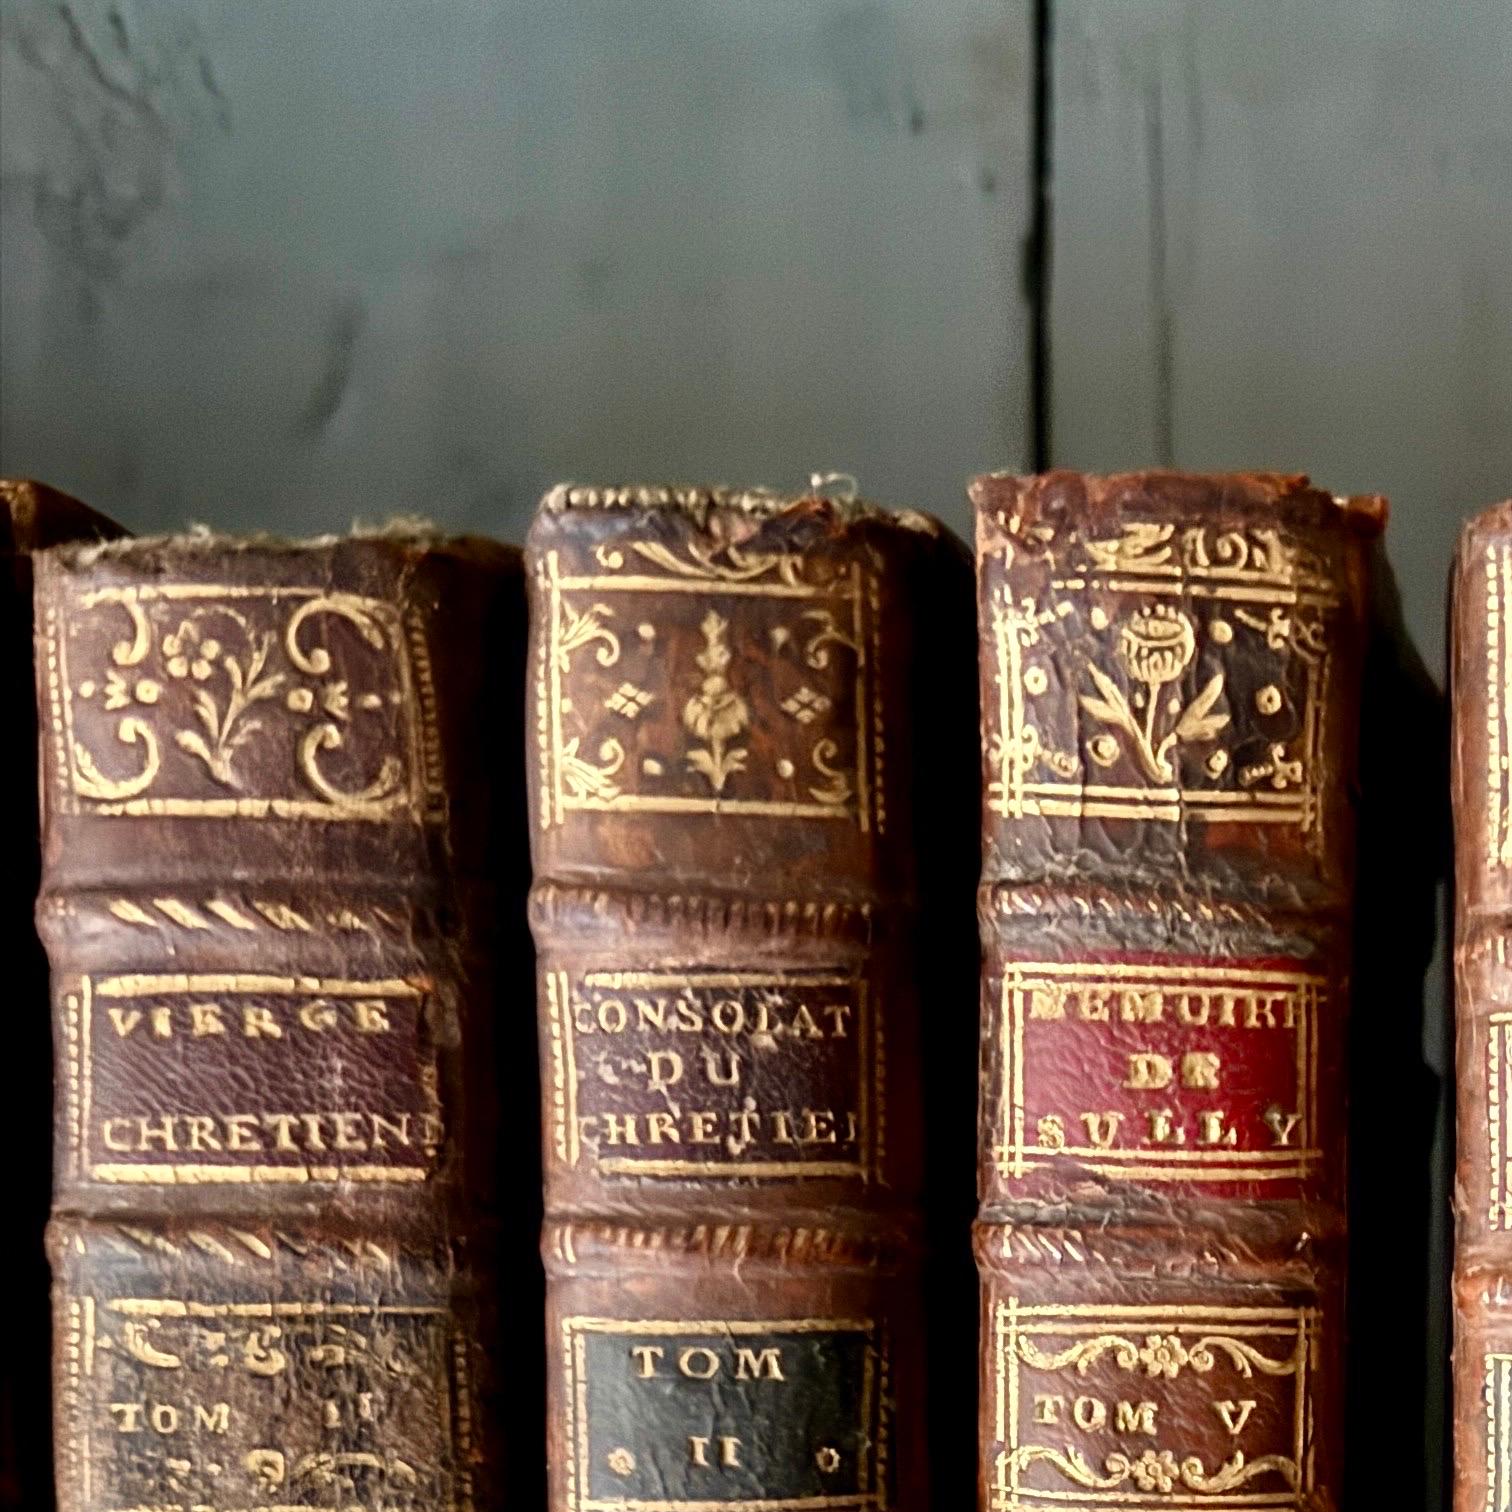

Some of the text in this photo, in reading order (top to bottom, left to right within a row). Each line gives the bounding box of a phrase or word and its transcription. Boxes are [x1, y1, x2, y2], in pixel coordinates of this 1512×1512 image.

[108, 999, 391, 1038] VIERGE
[573, 998, 851, 1039] CONSOLAT
[648, 1051, 744, 1087] DU
[1122, 1052, 1221, 1089] DE
[631, 1346, 785, 1381] TOM
[111, 1402, 230, 1434] TOM
[1033, 1395, 1257, 1435] TOM V
[687, 1436, 744, 1468] II
